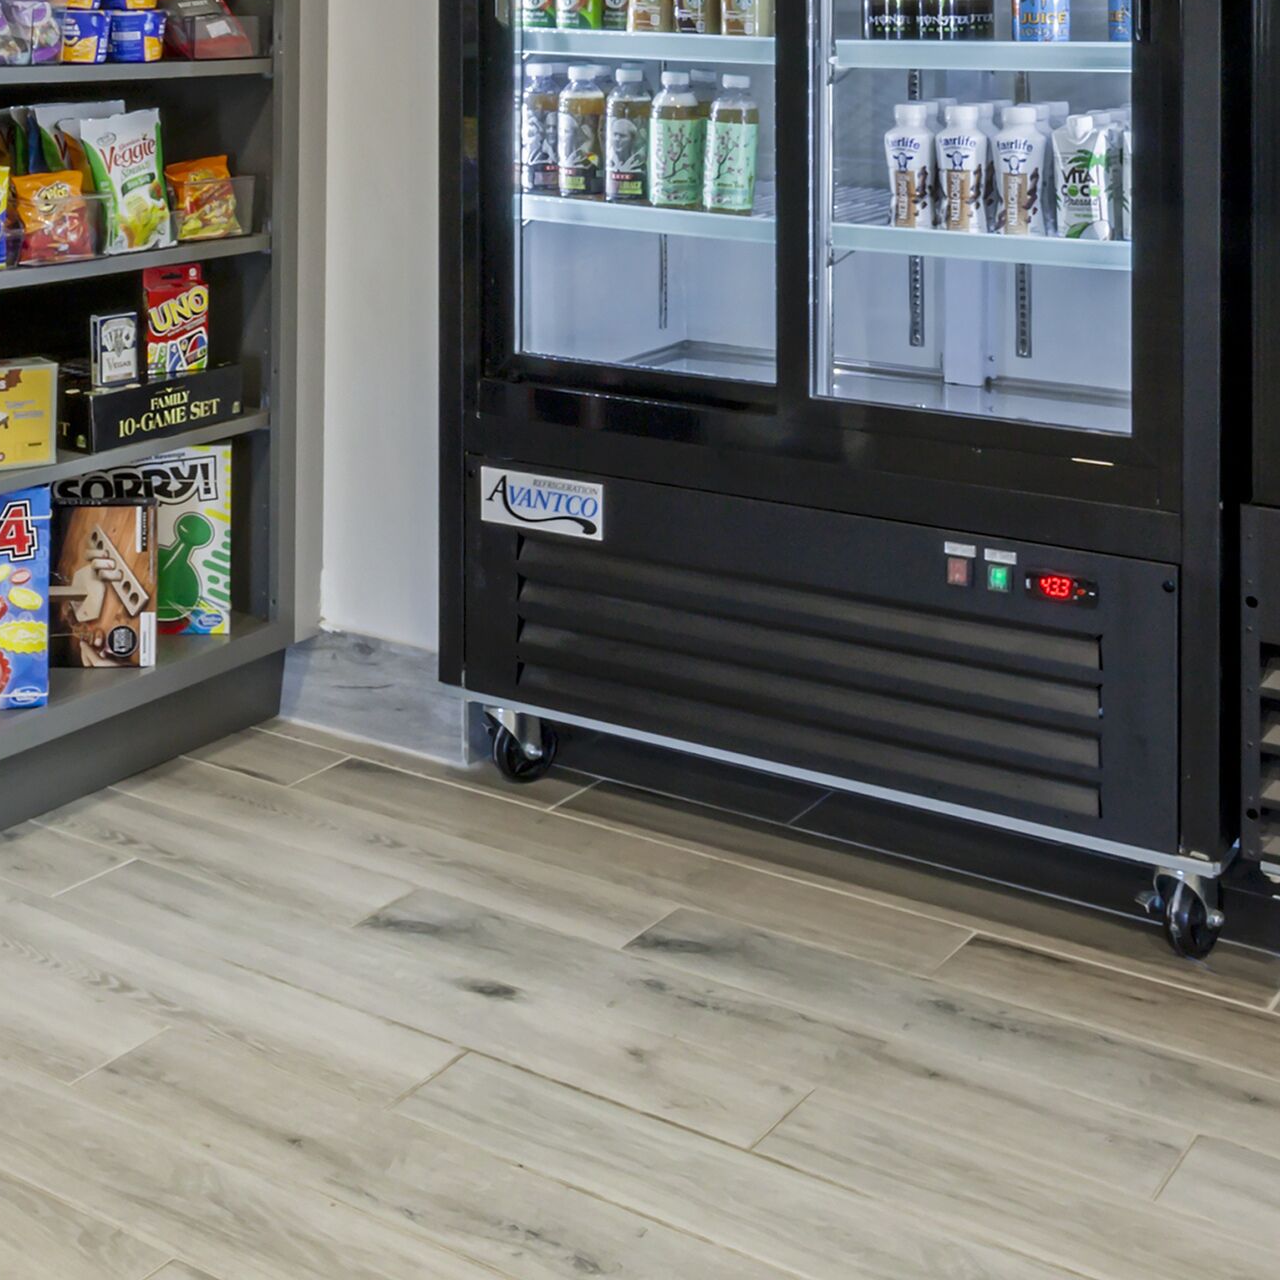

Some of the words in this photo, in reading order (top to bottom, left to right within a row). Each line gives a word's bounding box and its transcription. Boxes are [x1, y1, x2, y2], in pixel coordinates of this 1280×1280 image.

[1021, 12, 1067, 25] JUICE
[99, 137, 156, 175] Veggie
[1062, 169, 1095, 184] VITA
[1006, 182, 1020, 228] PROTEIN
[147, 285, 209, 336] UNO
[118, 402, 188, 438] 10-GAME
[190, 398, 220, 420] SET
[150, 390, 191, 411] FAMILY
[57, 462, 212, 500] SORRY!
[486, 474, 599, 521] AVANTCO
[532, 478, 599, 496] REFRIGERATION
